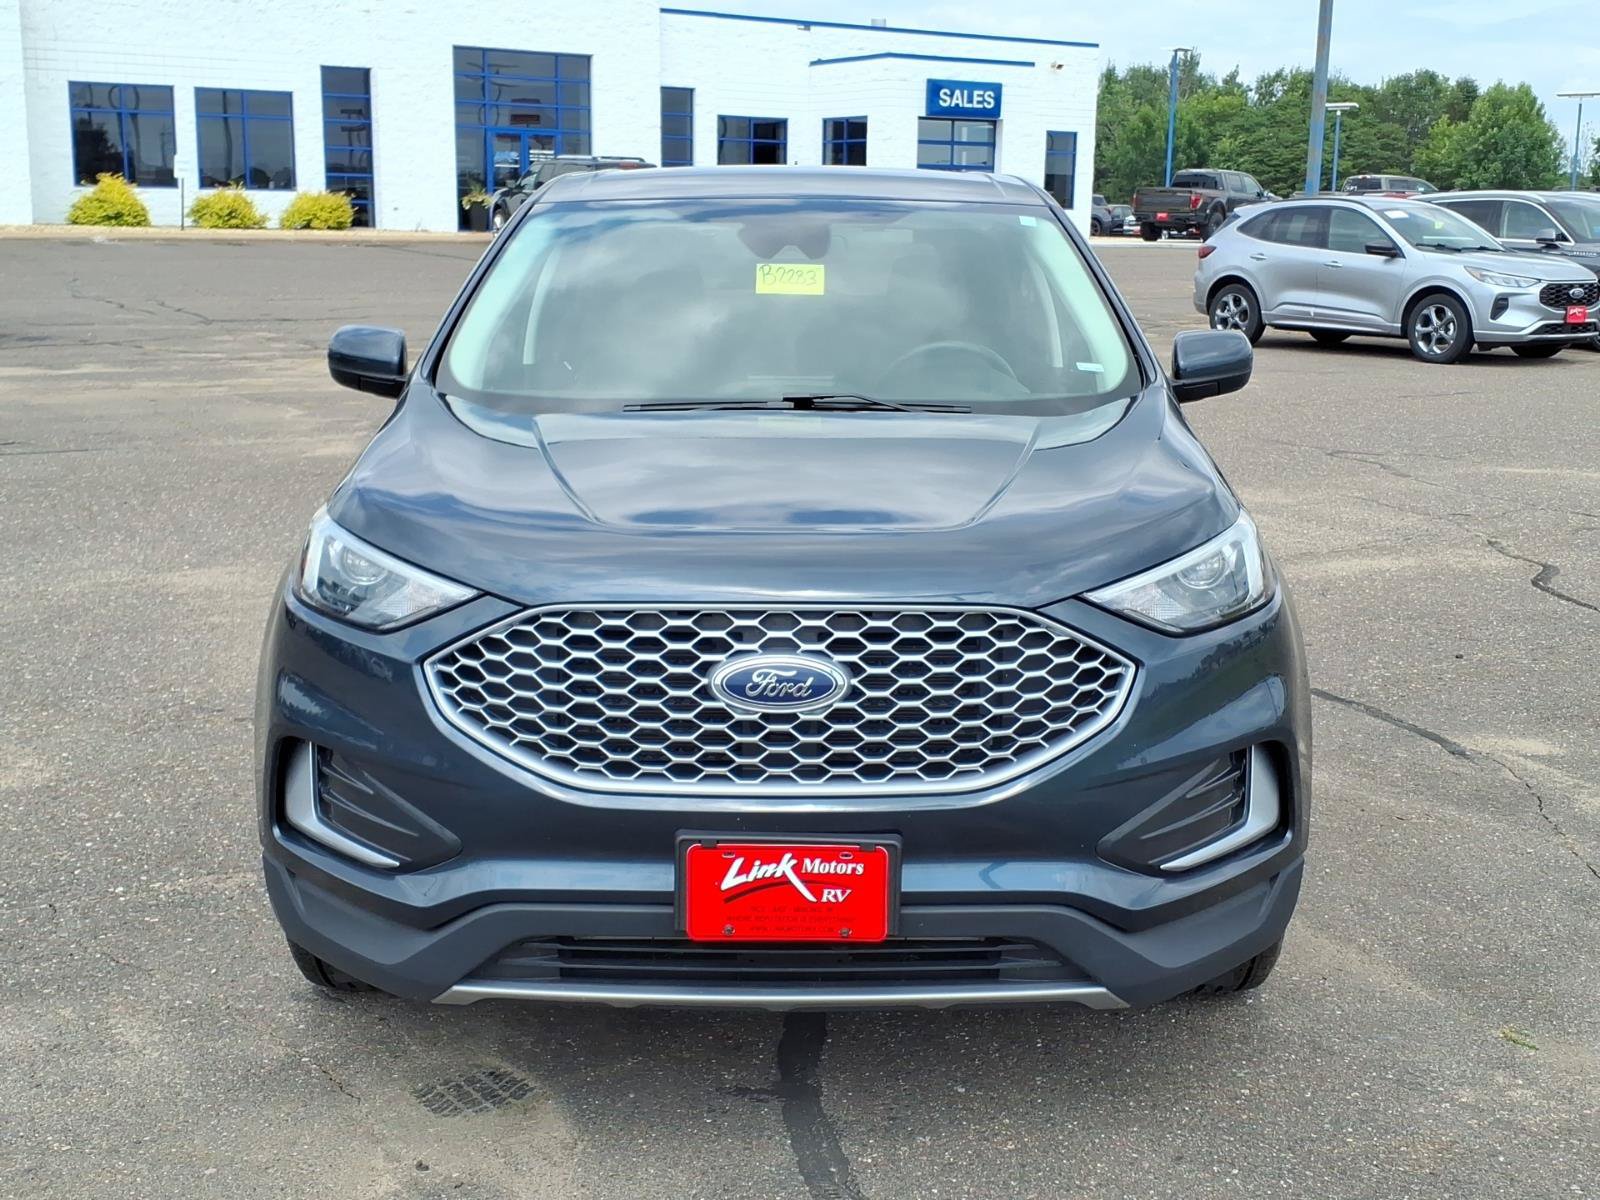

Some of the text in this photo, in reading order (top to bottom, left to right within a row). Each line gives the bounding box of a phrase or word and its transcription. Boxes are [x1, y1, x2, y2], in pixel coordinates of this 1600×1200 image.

[939, 88, 995, 109] SALES
[745, 668, 815, 698] Ford
[720, 852, 865, 903] Link Motors
[821, 888, 852, 903] RV
